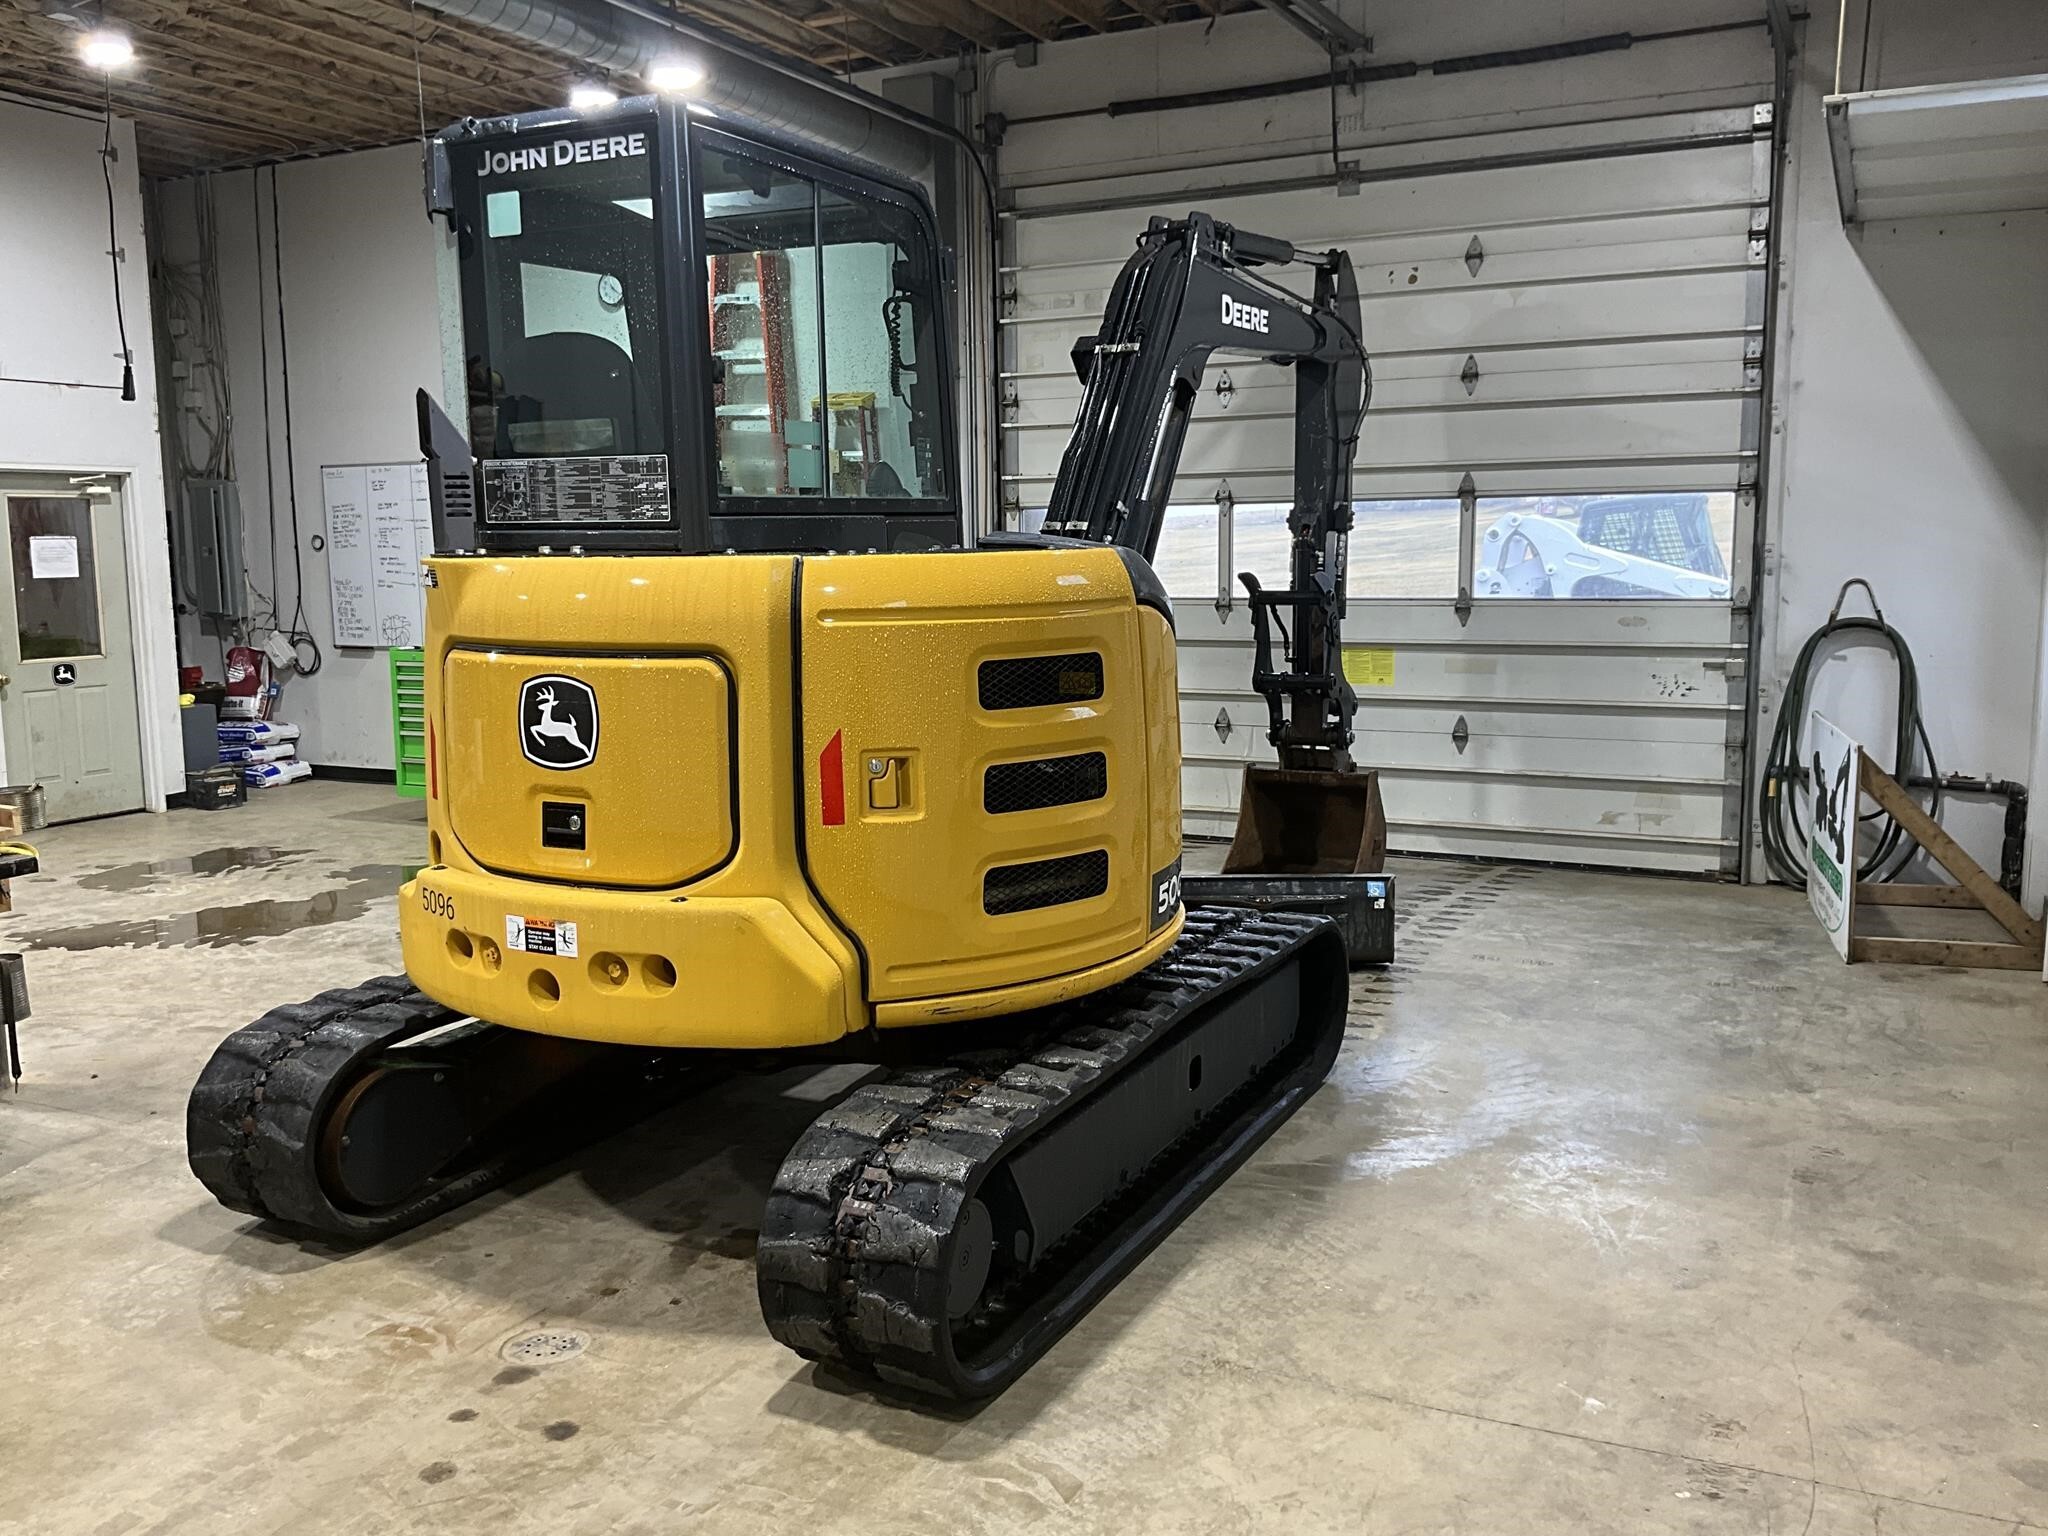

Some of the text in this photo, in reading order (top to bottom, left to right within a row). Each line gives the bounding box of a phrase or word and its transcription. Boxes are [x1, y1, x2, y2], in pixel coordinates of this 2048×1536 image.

[478, 133, 646, 177] JOHN DEERE
[1221, 293, 1269, 334] DEERE
[422, 886, 455, 920] 5096
